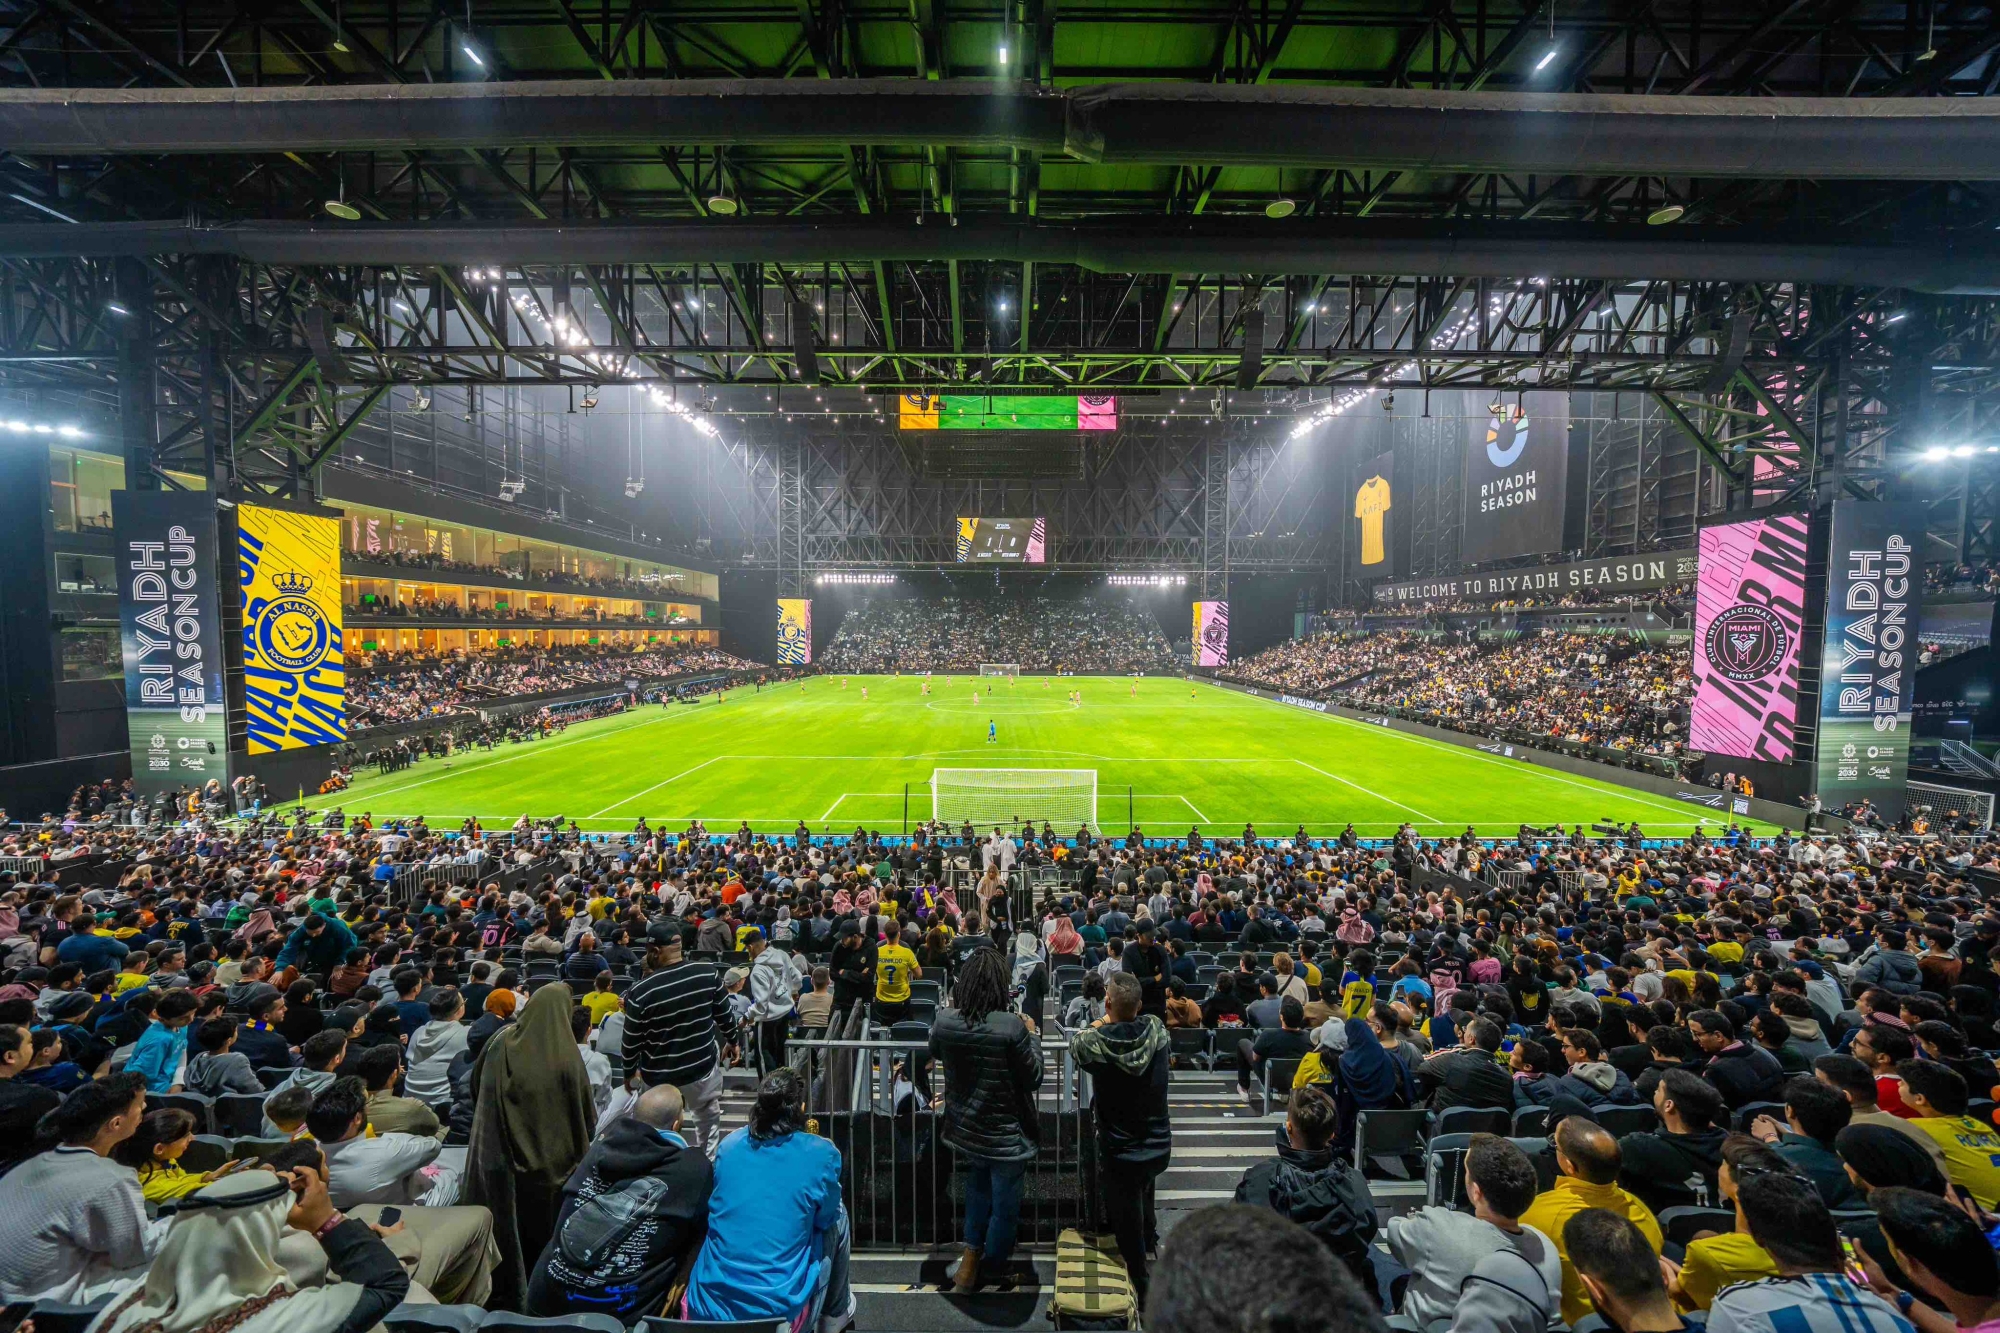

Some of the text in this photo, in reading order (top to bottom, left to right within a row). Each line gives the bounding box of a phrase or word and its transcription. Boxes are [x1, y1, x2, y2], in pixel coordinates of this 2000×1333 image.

[1481, 470, 1537, 497] RIYADH
[1480, 488, 1537, 513] SEASON
[169, 525, 197, 590] CUP
[1885, 534, 1911, 598] CUP
[1397, 579, 1457, 600] WELCOME
[1463, 580, 1482, 595] TO
[1489, 572, 1559, 593] RIYADH
[1569, 561, 1666, 587] SEASON
[130, 541, 174, 703] RIYADH
[268, 602, 321, 623] AL NASSR
[1708, 607, 1771, 638] INTERNACIONAL
[1771, 620, 1781, 632] DE
[1839, 551, 1881, 712] RIYADH
[172, 594, 206, 722] SEASON
[267, 648, 322, 665] FOOTBALL CLUB
[1706, 642, 1716, 662] CLUB
[1873, 604, 1907, 732] SEASON
[1298, 697, 1315, 710] SEASON
[1315, 702, 1326, 712] CUP
[884, 965, 897, 985] 7
[1351, 995, 1366, 1014] 7
